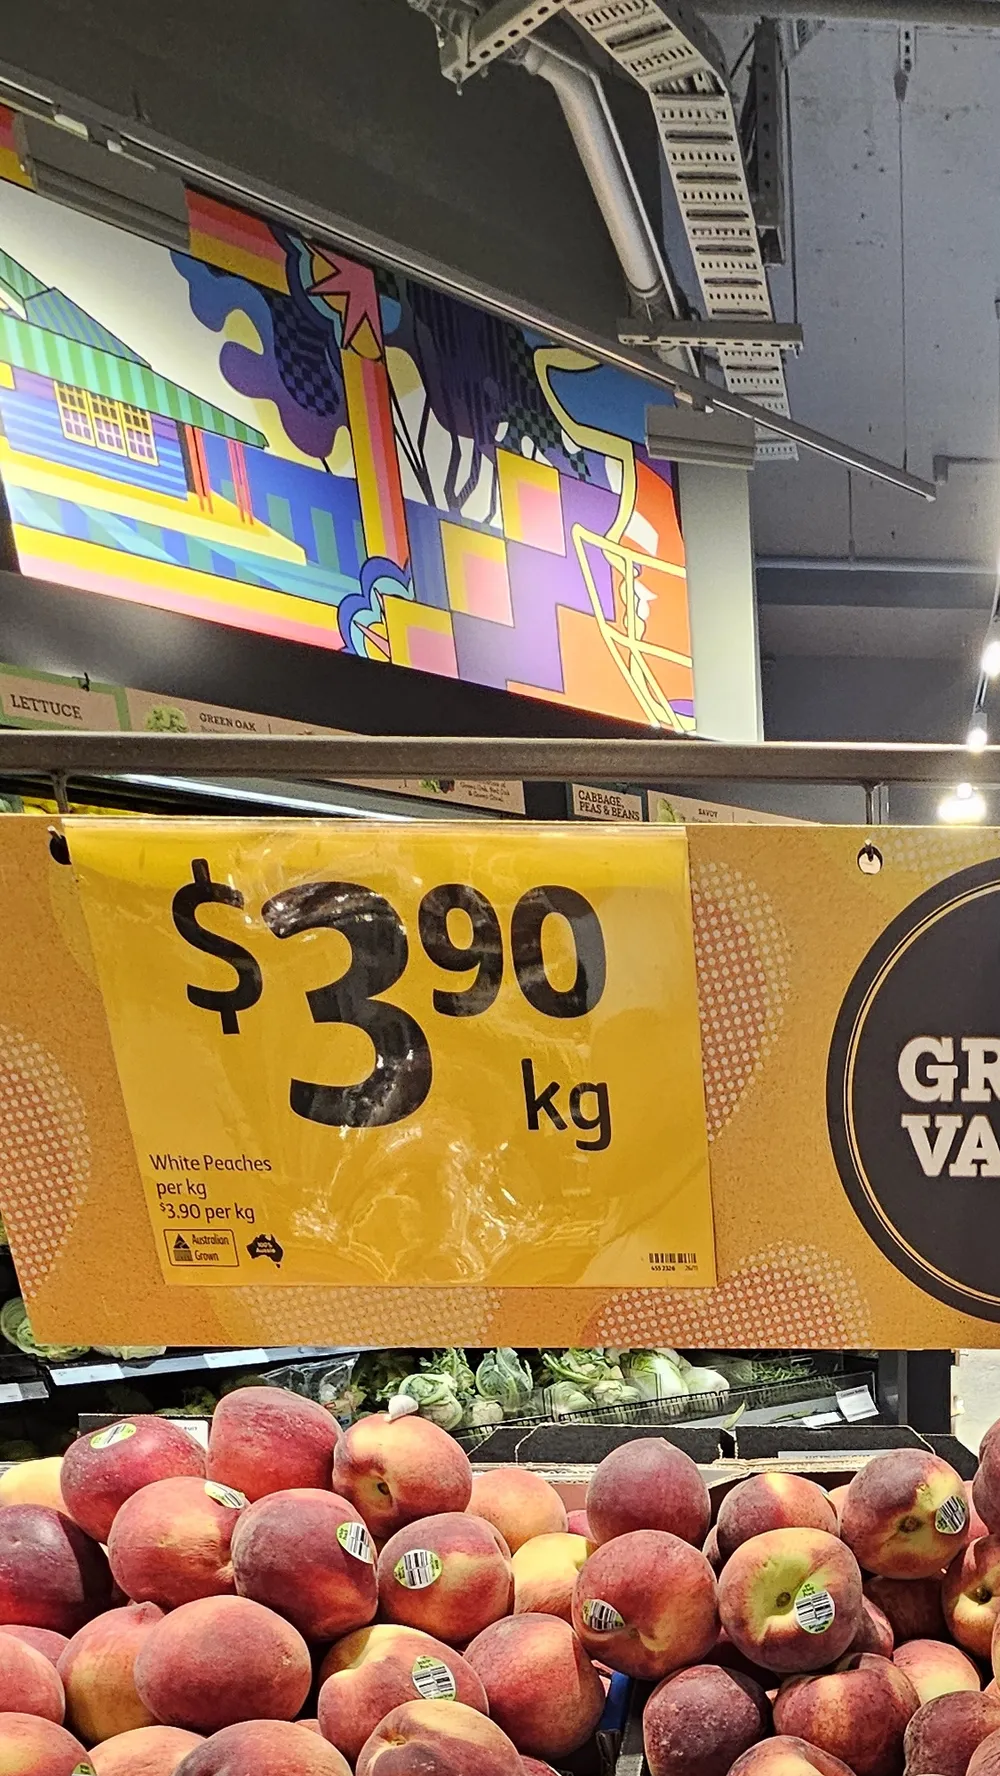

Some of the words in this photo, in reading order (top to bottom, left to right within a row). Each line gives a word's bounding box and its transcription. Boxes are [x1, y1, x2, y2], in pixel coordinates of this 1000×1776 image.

[10, 694, 83, 721] LETTUCE
[200, 712, 233, 727] GREEN
[235, 719, 256, 732] OAK
[578, 789, 624, 809] CABBAGE,
[579, 801, 602, 814] PEAS
[603, 805, 610, 815] &
[611, 807, 640, 821] BEANS
[520, 1058, 612, 1152] kg
[149, 1153, 201, 1171] White
[203, 1153, 272, 1172] Peaches
[156, 1182, 182, 1199] per
[186, 1178, 207, 1200] kg
[159, 1202, 201, 1219] $3.90
[205, 1205, 231, 1224] per
[234, 1202, 255, 1224] kg
[192, 1233, 230, 1246] Australian
[194, 1250, 219, 1262] Grown
